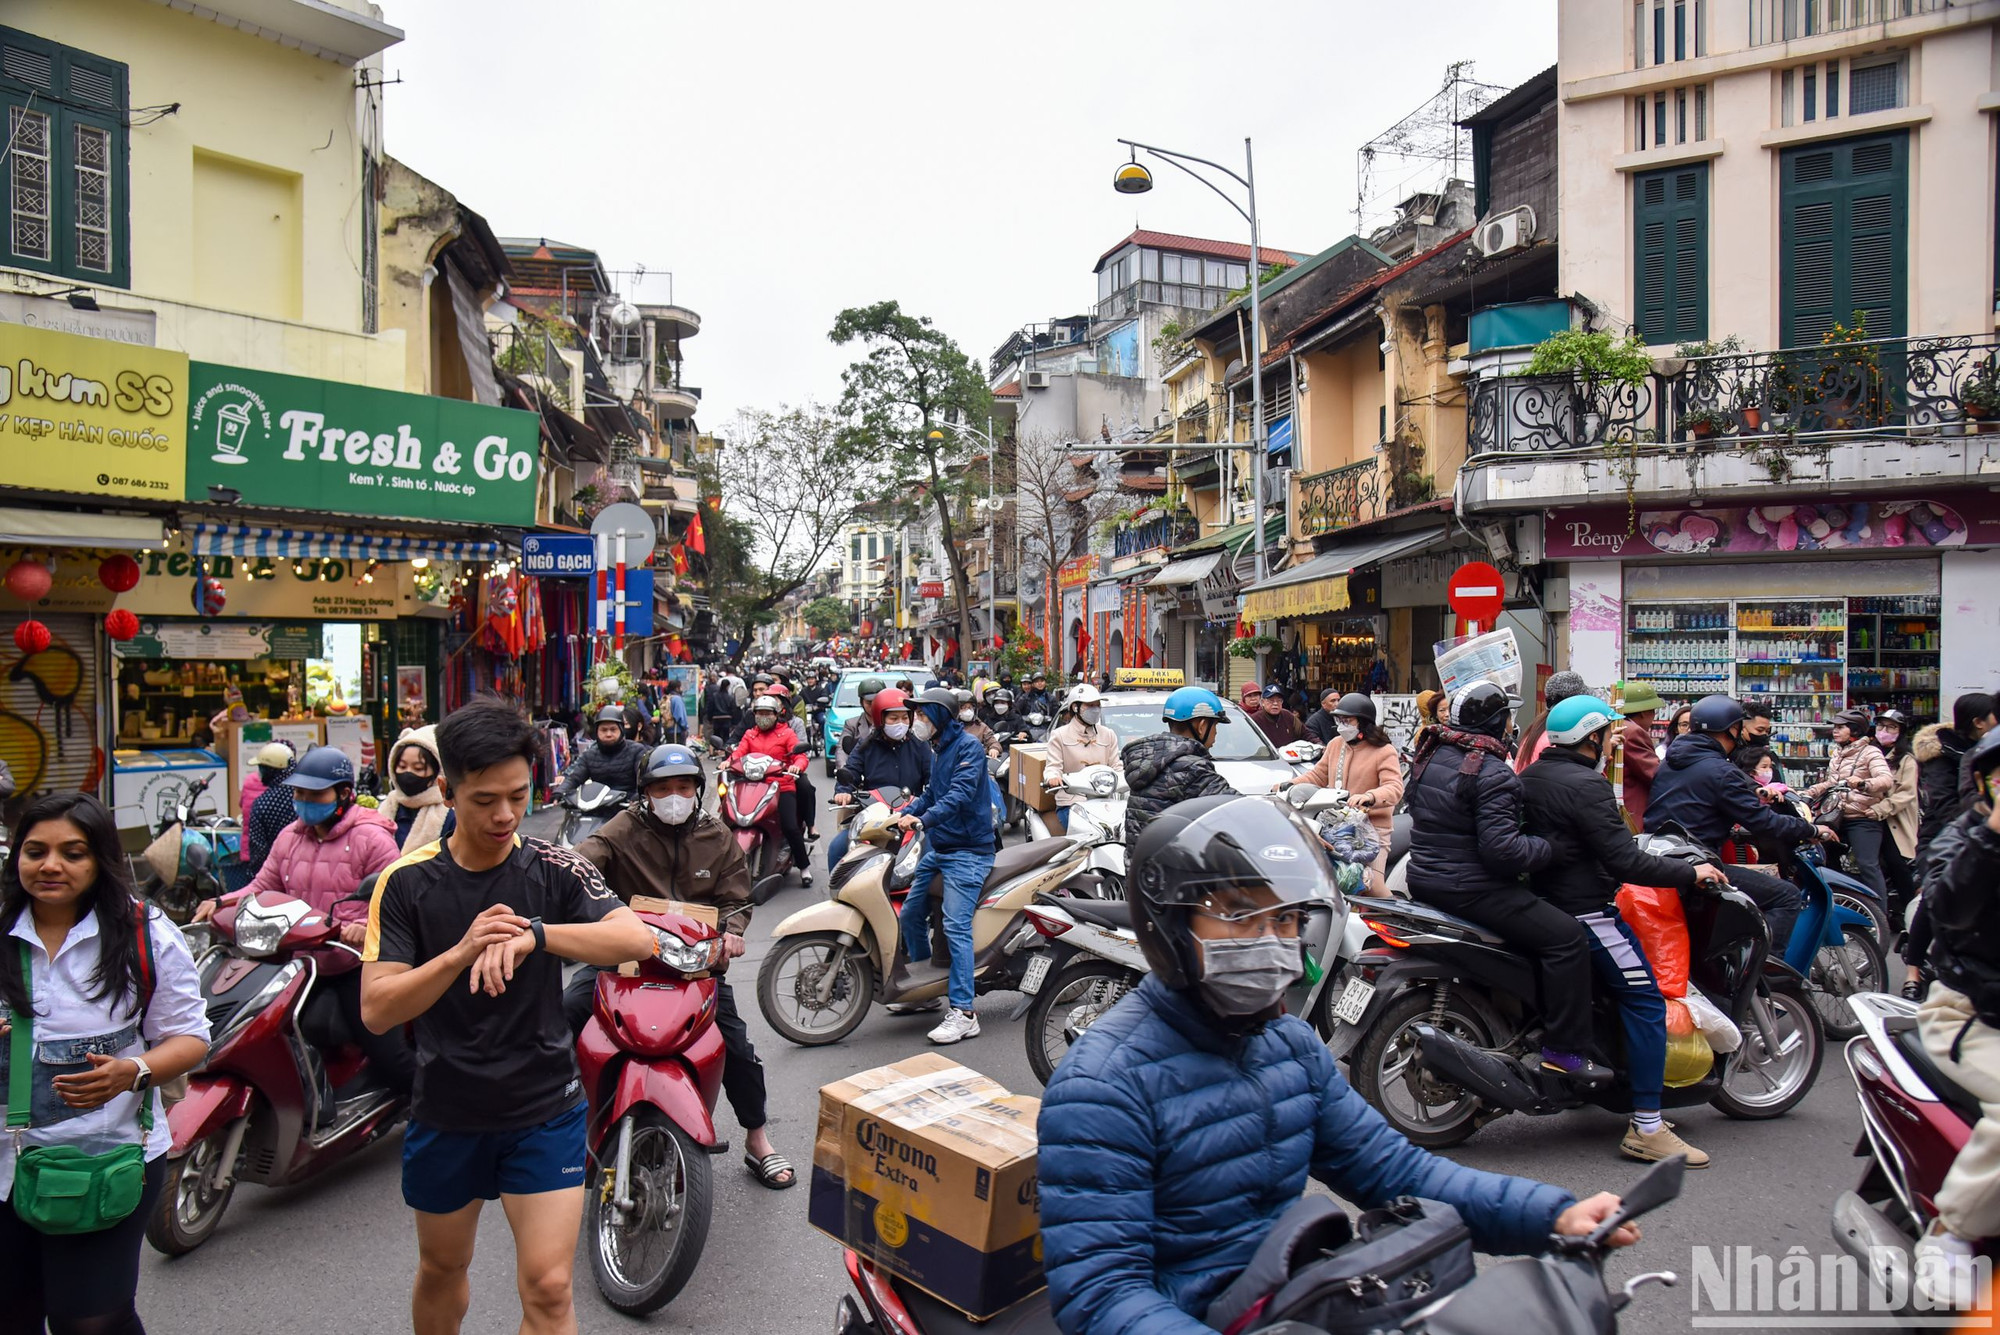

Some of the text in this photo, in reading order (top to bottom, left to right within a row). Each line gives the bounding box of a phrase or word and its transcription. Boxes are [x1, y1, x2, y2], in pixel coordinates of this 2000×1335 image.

[115, 370, 174, 417] SS
[205, 382, 224, 399] and
[224, 383, 266, 411] smoothie
[262, 412, 272, 430] bar
[14, 413, 55, 442] KẸP
[59, 419, 104, 444] HÀN
[108, 427, 170, 452] QUỐC
[279, 410, 533, 482] Fresh & Go
[112, 476, 169, 490] 087 686 2332
[349, 473, 374, 486] Kem
[391, 476, 414, 489] Sinh
[415, 476, 428, 491] tố
[462, 482, 476, 497] ép
[1565, 522, 1629, 553] Poêmy
[527, 552, 592, 572] NGÕ GẠCH
[1336, 996, 1363, 1021] 549.98
[1346, 981, 1370, 1003] 29-V7
[856, 1118, 937, 1177] Corona
[874, 1153, 918, 1192] Extra
